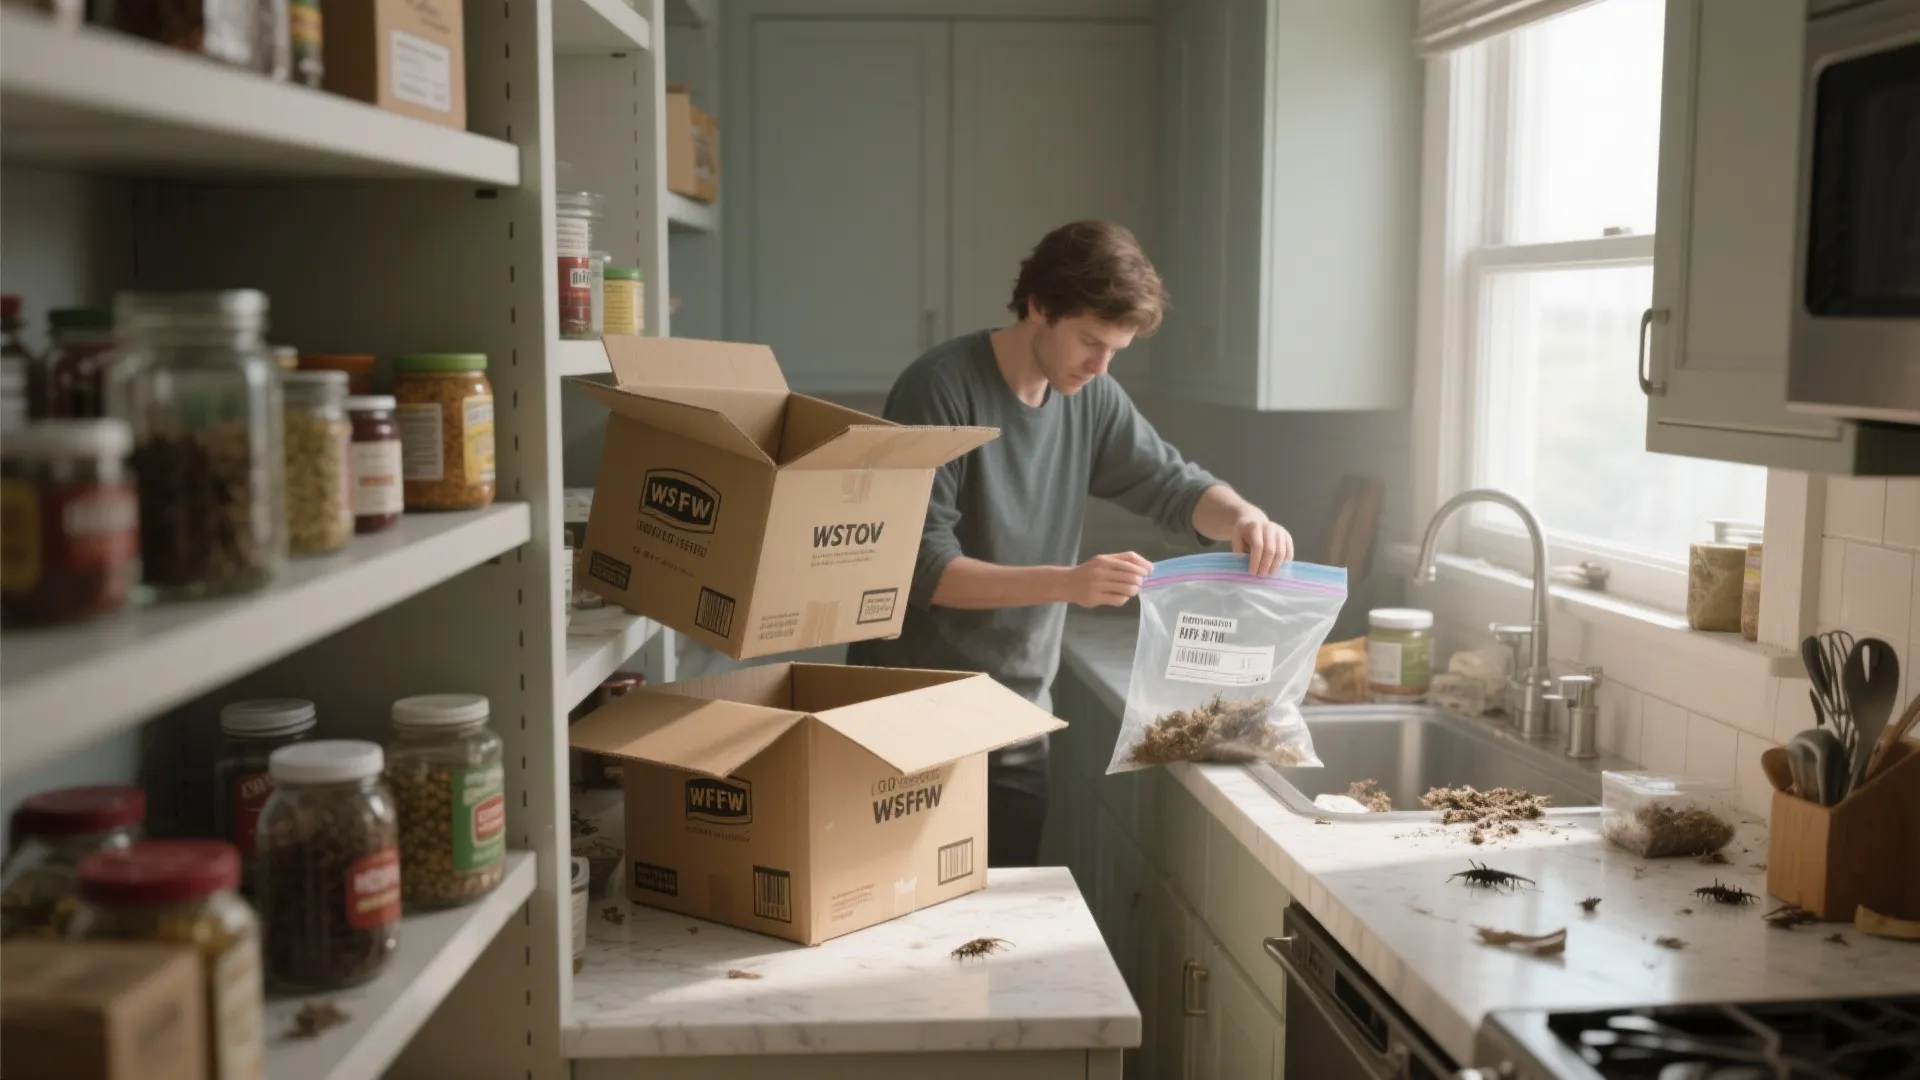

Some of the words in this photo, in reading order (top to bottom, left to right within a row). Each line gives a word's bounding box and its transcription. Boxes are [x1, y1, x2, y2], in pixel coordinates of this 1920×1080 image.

[651, 482, 711, 519] WSFW
[813, 521, 885, 548] WSTOV
[690, 787, 744, 811] WFFW
[872, 783, 942, 824] WSFFW
